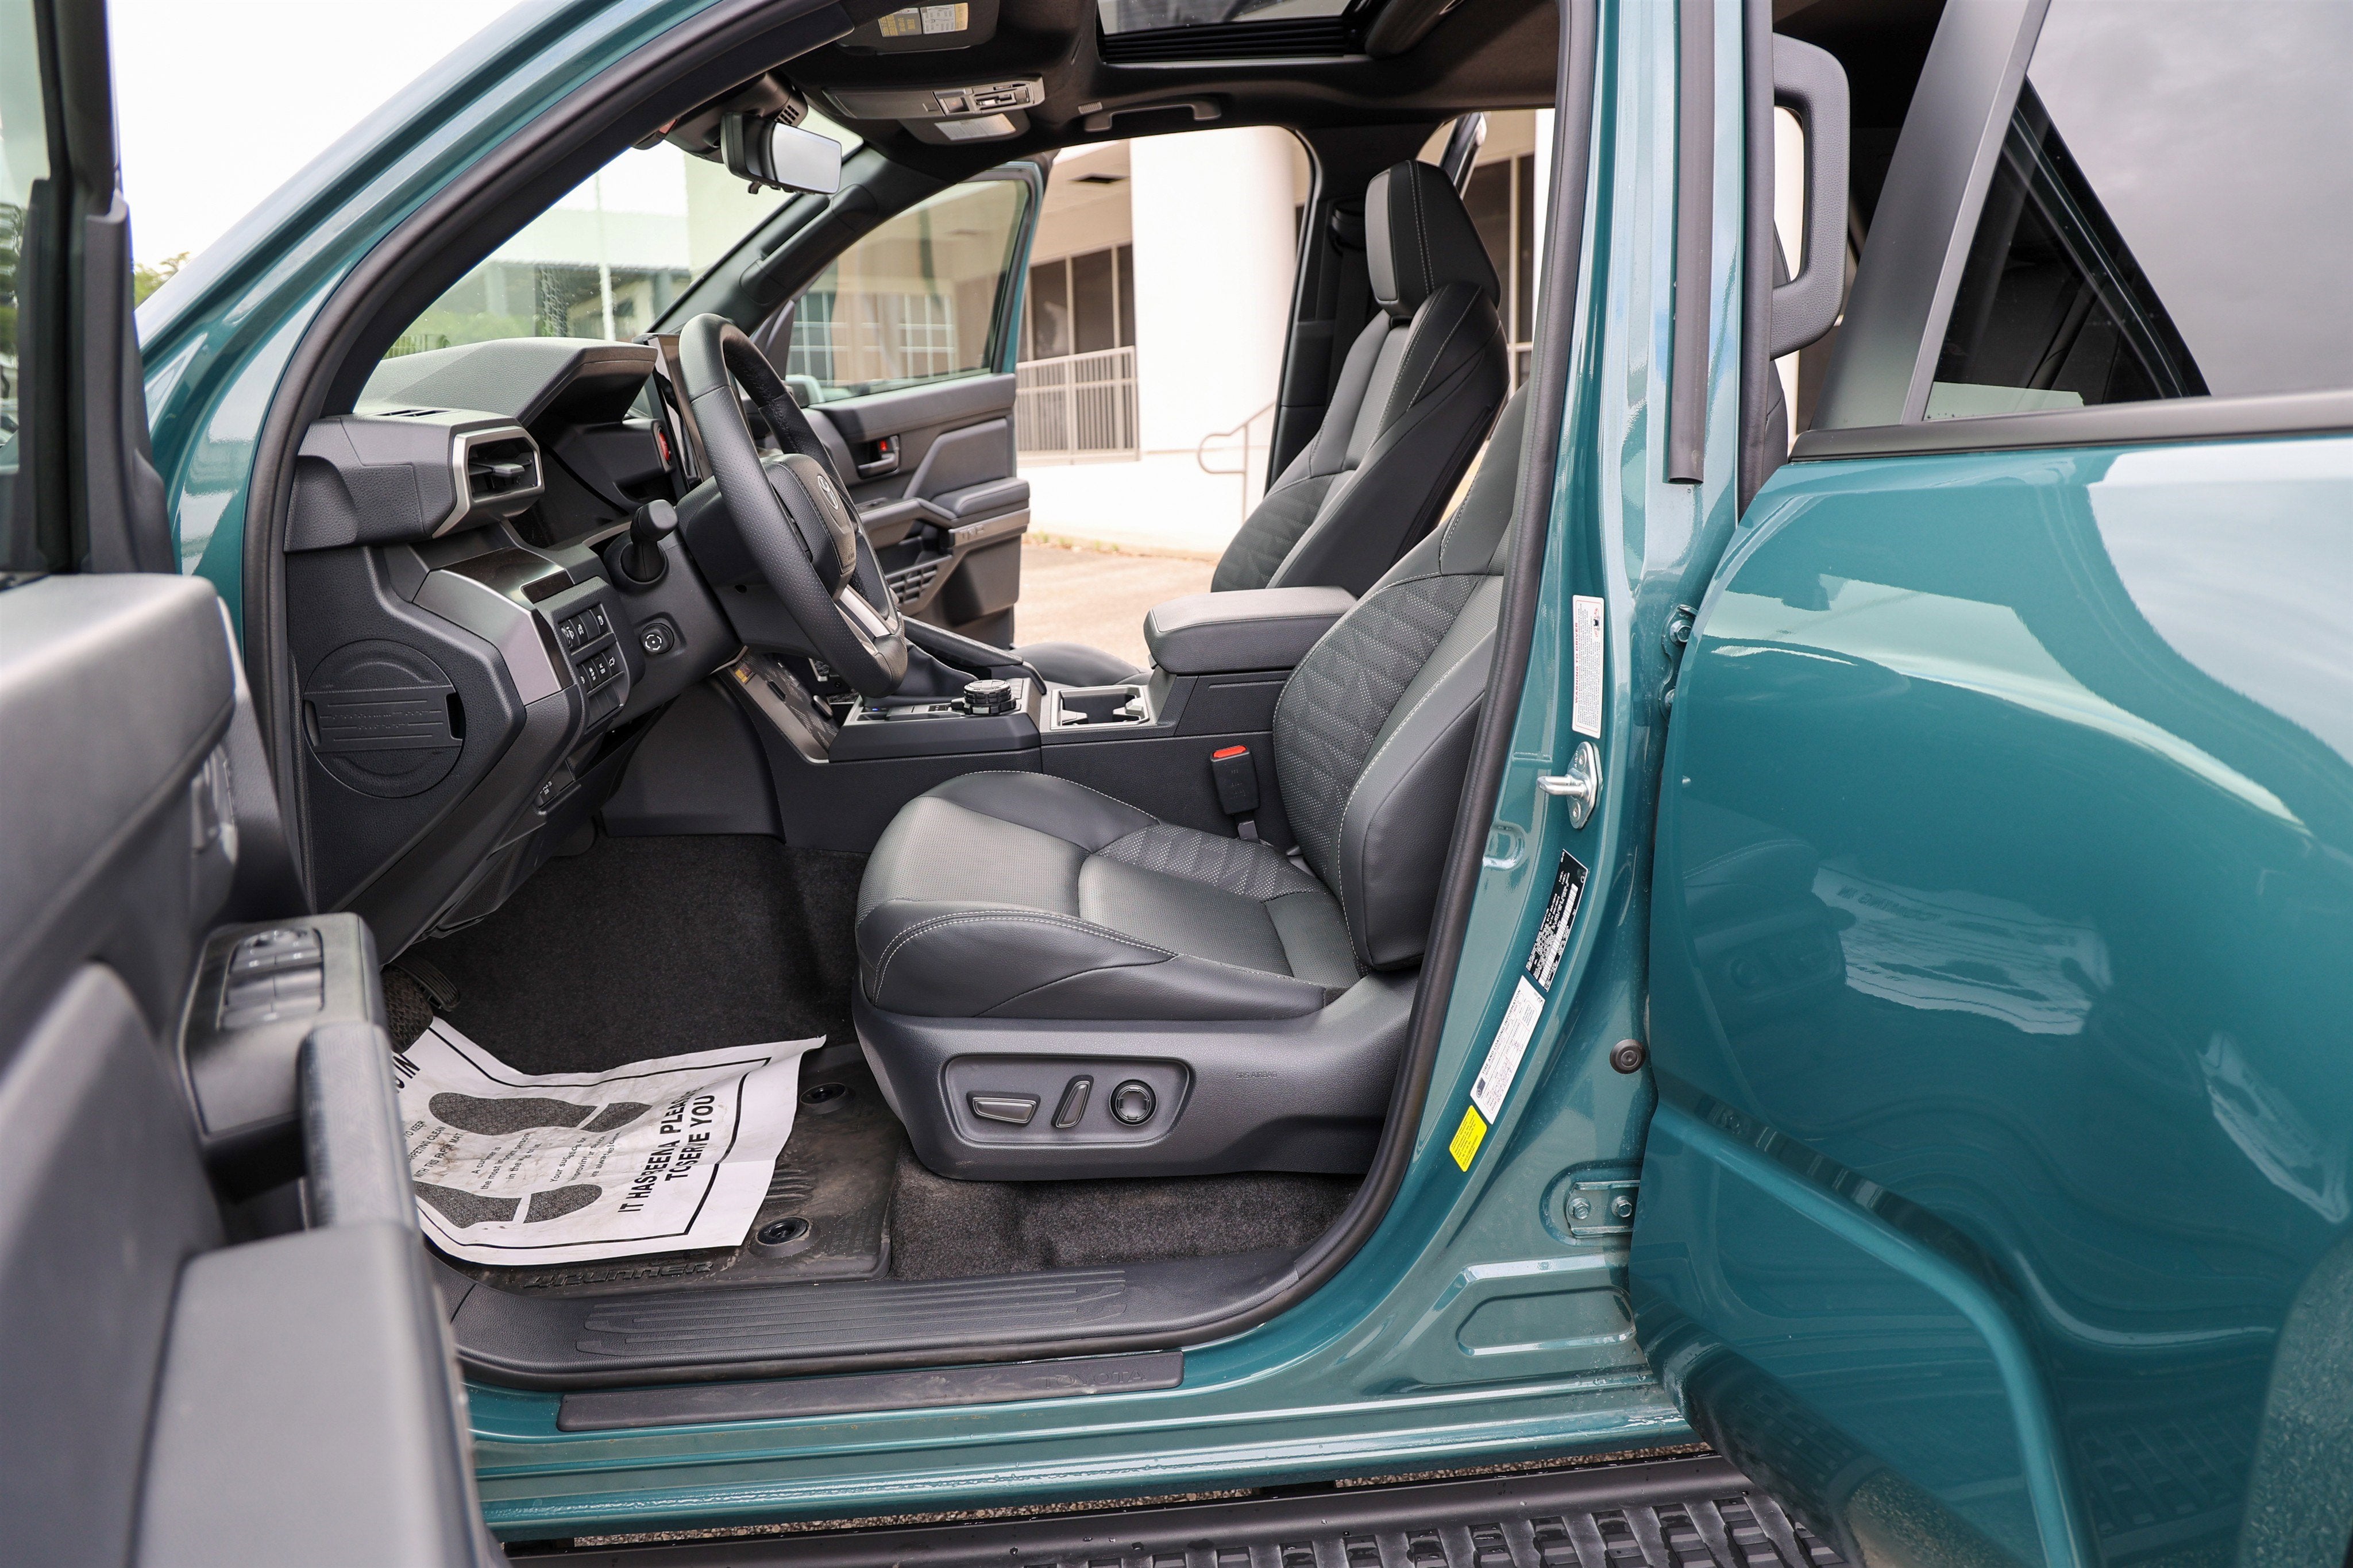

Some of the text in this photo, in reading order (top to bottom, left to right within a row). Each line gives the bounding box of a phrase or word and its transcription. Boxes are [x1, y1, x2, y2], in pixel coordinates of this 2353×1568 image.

[1576, 653, 1578, 663] TO
[1492, 1025, 1505, 1051] LOADING
[1503, 988, 1521, 1026] INFORMATION
[689, 1095, 715, 1127] YOU
[407, 1126, 447, 1162] ARPETING CLEAN
[449, 1132, 464, 1148] MAT
[658, 1140, 680, 1149] A
[510, 1161, 522, 1172] the
[641, 1148, 676, 1176] BEEN
[480, 1180, 492, 1190] the
[488, 1165, 502, 1180] most
[549, 1169, 564, 1183] Your
[626, 1175, 658, 1199] HAS
[617, 1203, 644, 1213] IT
[1040, 1369, 1148, 1389] TOYOTA
